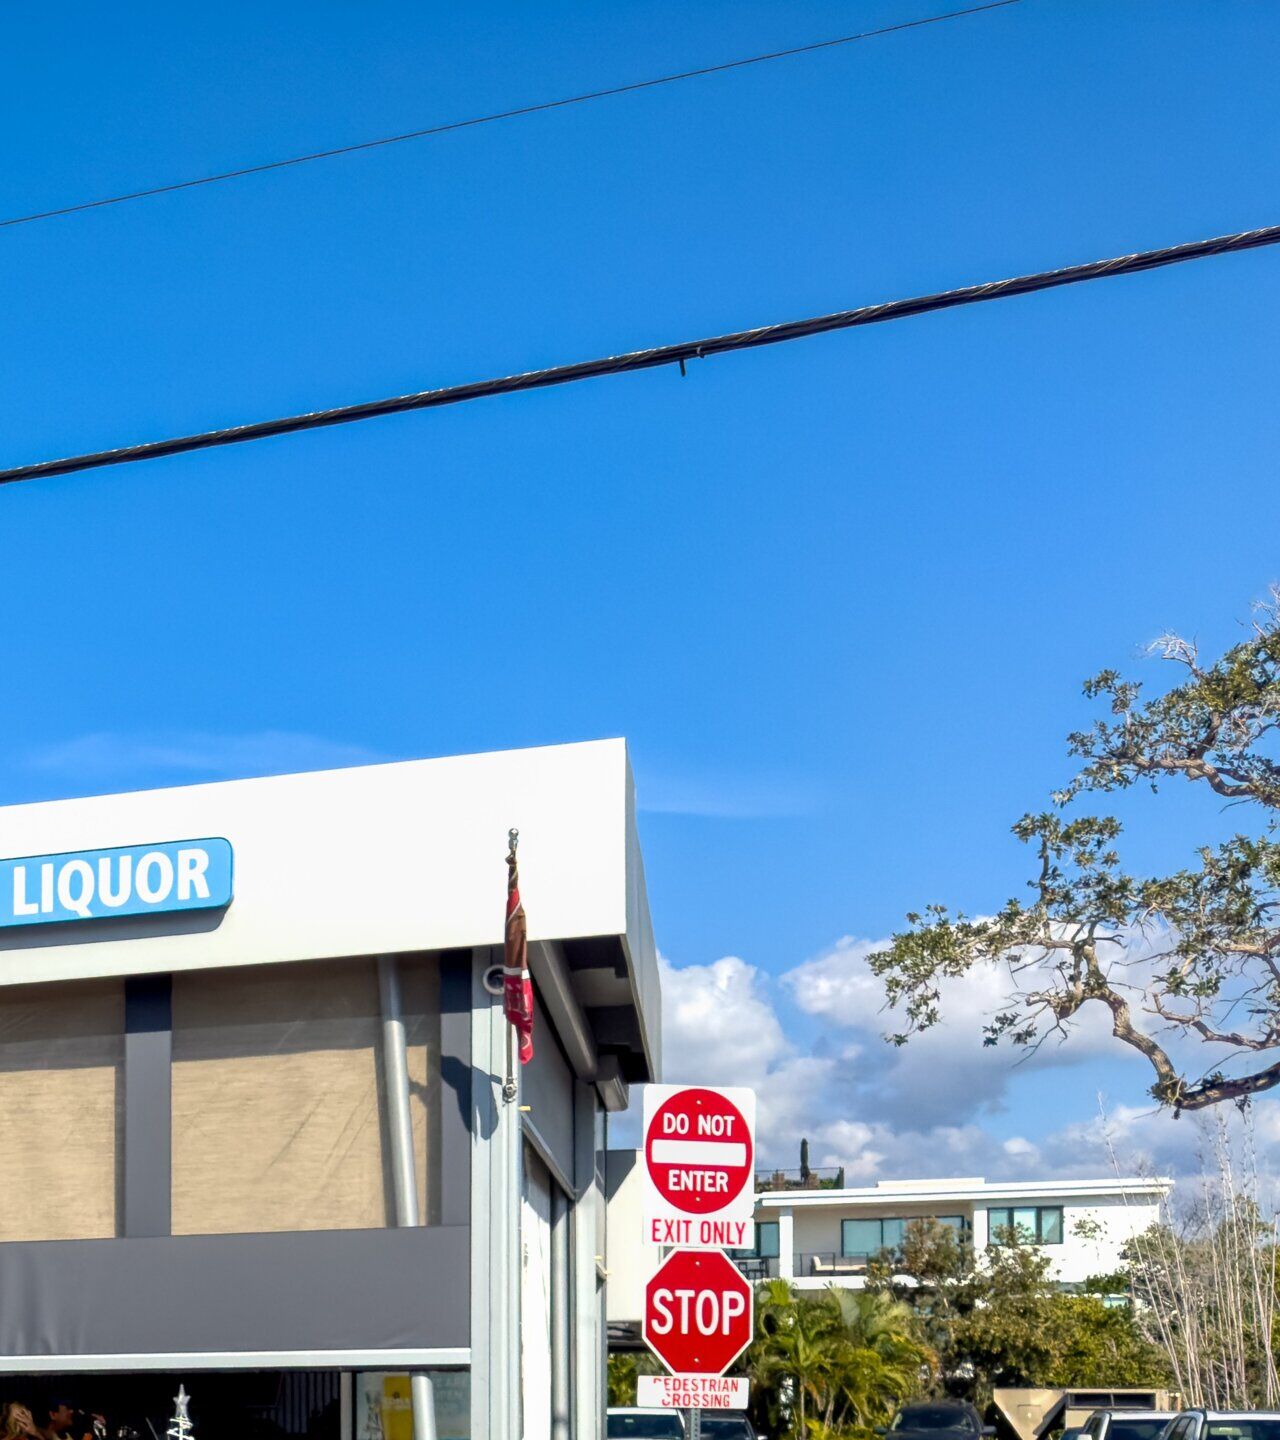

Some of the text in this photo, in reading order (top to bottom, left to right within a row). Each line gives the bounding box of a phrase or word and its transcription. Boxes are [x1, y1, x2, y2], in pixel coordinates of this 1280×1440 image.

[12, 847, 211, 918] LIQUOR
[663, 1113, 735, 1137] DO NOT
[668, 1169, 728, 1193] ENTER
[651, 1218, 746, 1245] EXIT ONLY
[651, 1288, 746, 1336] STOP
[653, 1378, 739, 1392] EDESTRIAN
